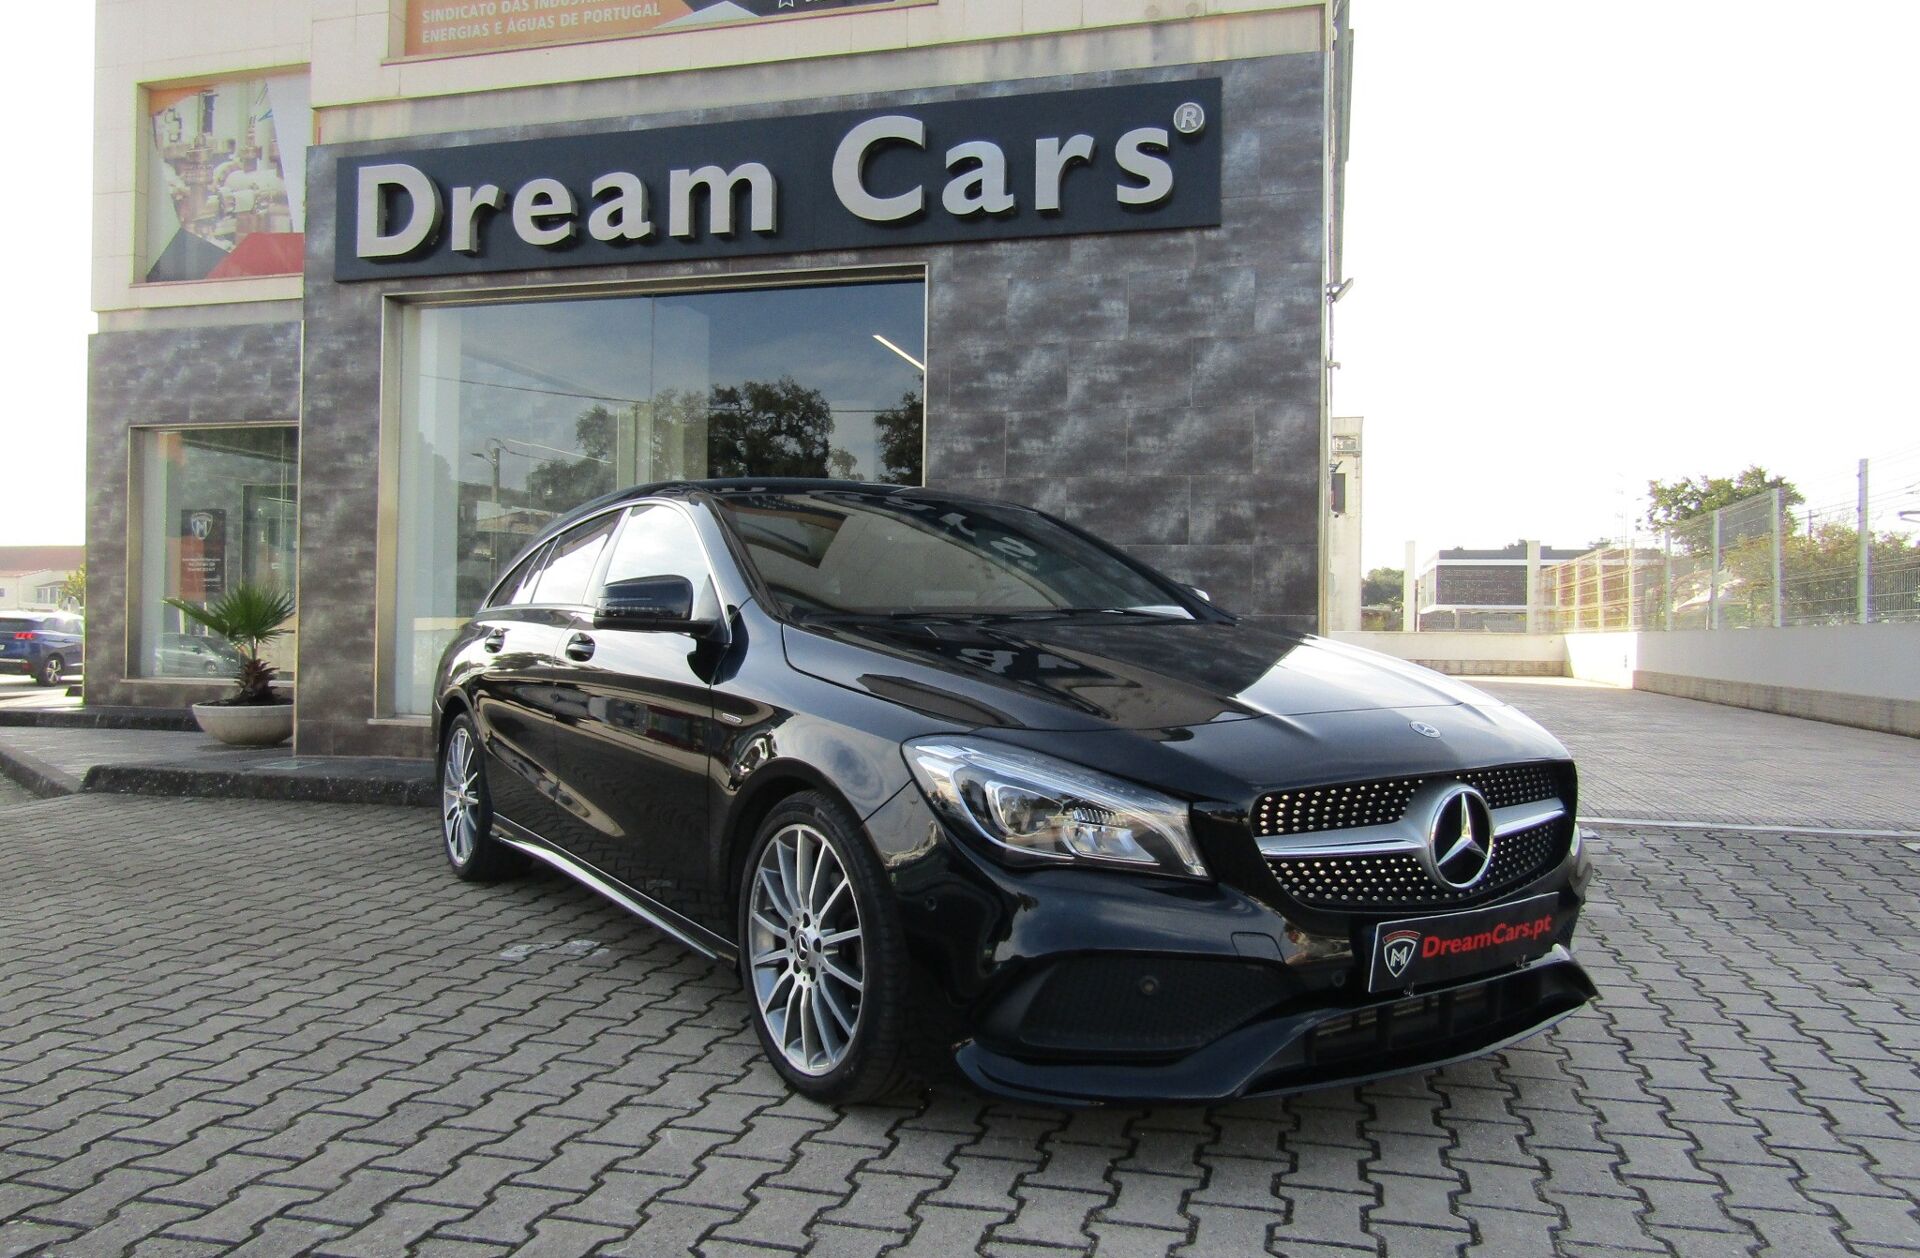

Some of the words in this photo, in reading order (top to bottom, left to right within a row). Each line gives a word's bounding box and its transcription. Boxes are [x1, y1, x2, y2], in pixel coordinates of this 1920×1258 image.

[422, 2, 496, 24] SINDICATO
[502, 0, 530, 14] DAS
[422, 23, 489, 43] ENERGIAS
[495, 21, 503, 35] E
[507, 15, 555, 34] ÁGUAS
[560, 12, 579, 27] DE
[584, 3, 661, 24] PORTUGAL
[356, 161, 779, 258] Dream
[832, 114, 1174, 221] Cars
[1421, 914, 1553, 958] DreamCars.pt
